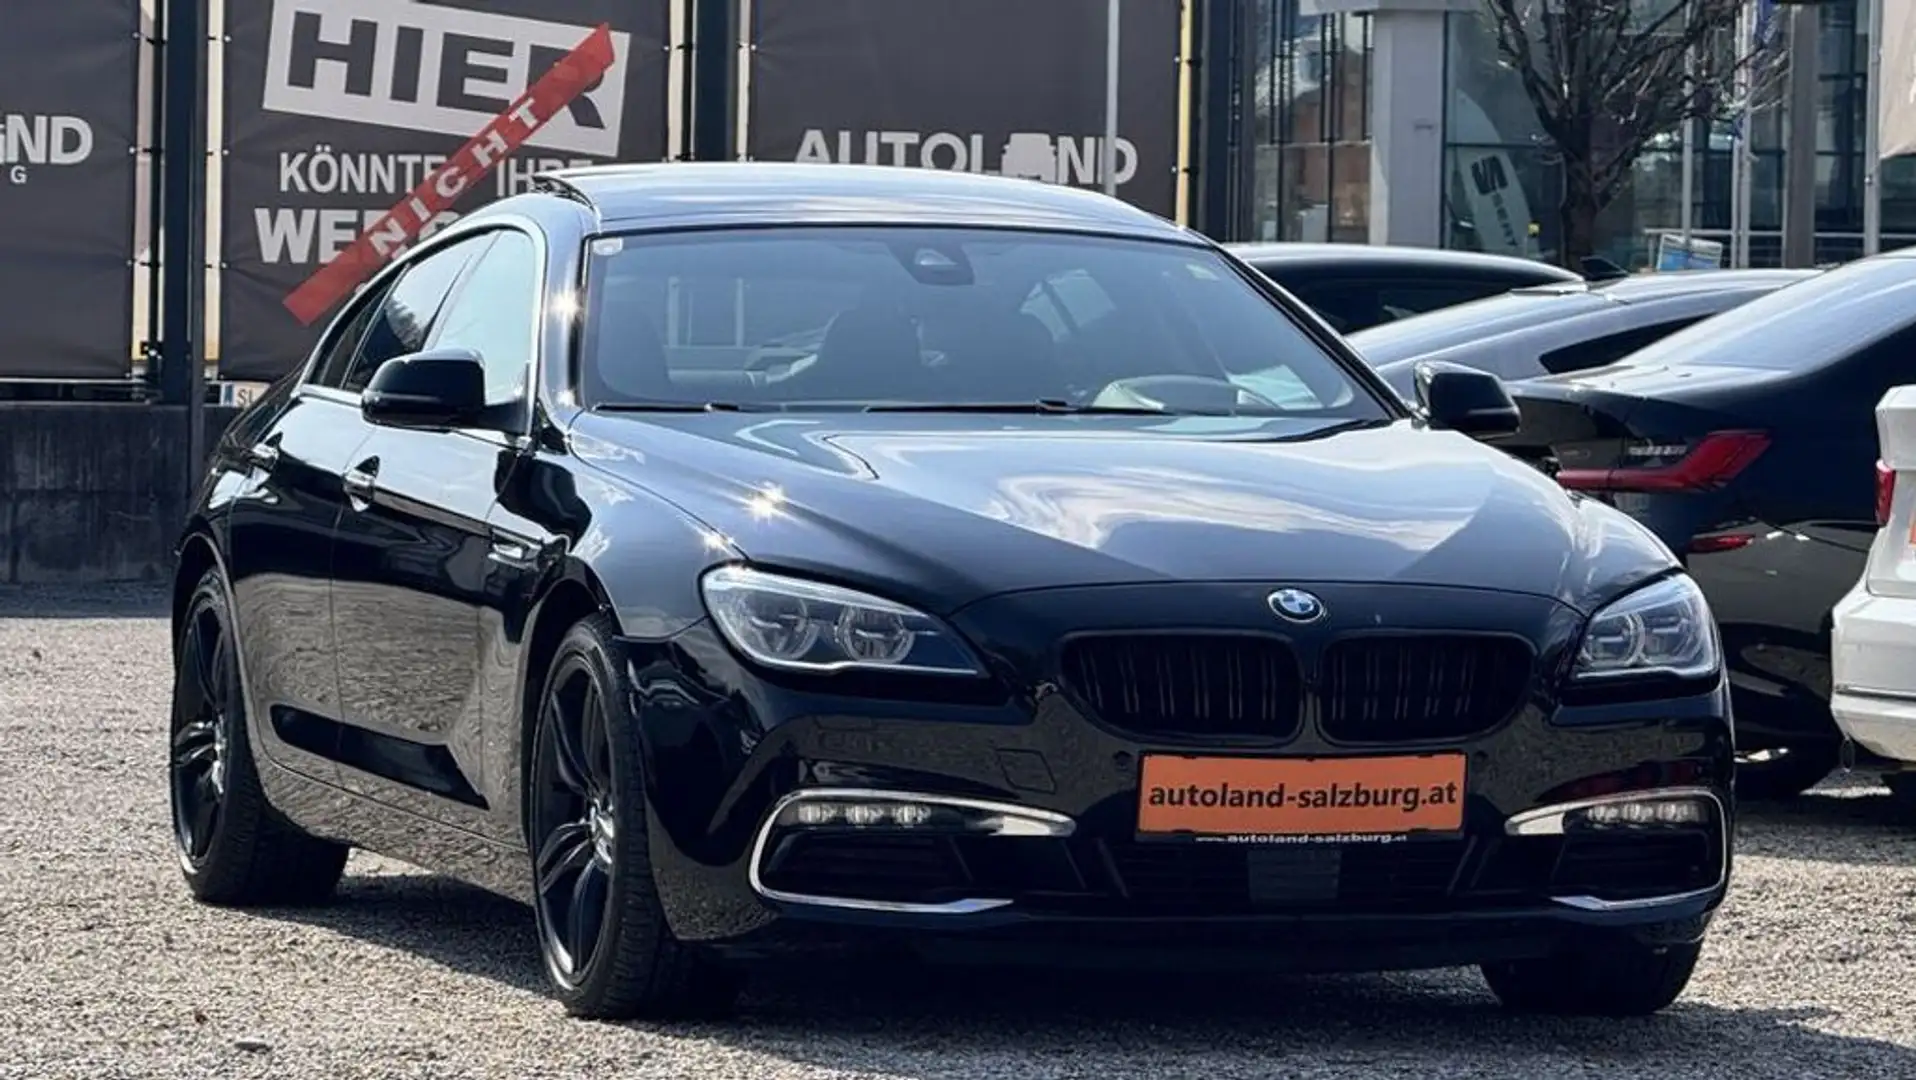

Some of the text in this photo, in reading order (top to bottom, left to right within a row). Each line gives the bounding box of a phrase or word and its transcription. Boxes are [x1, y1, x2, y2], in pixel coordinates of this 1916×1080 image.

[10, 165, 27, 184] G
[370, 97, 541, 257] NICHT
[1150, 782, 1457, 812] autoland-salzburg.at
